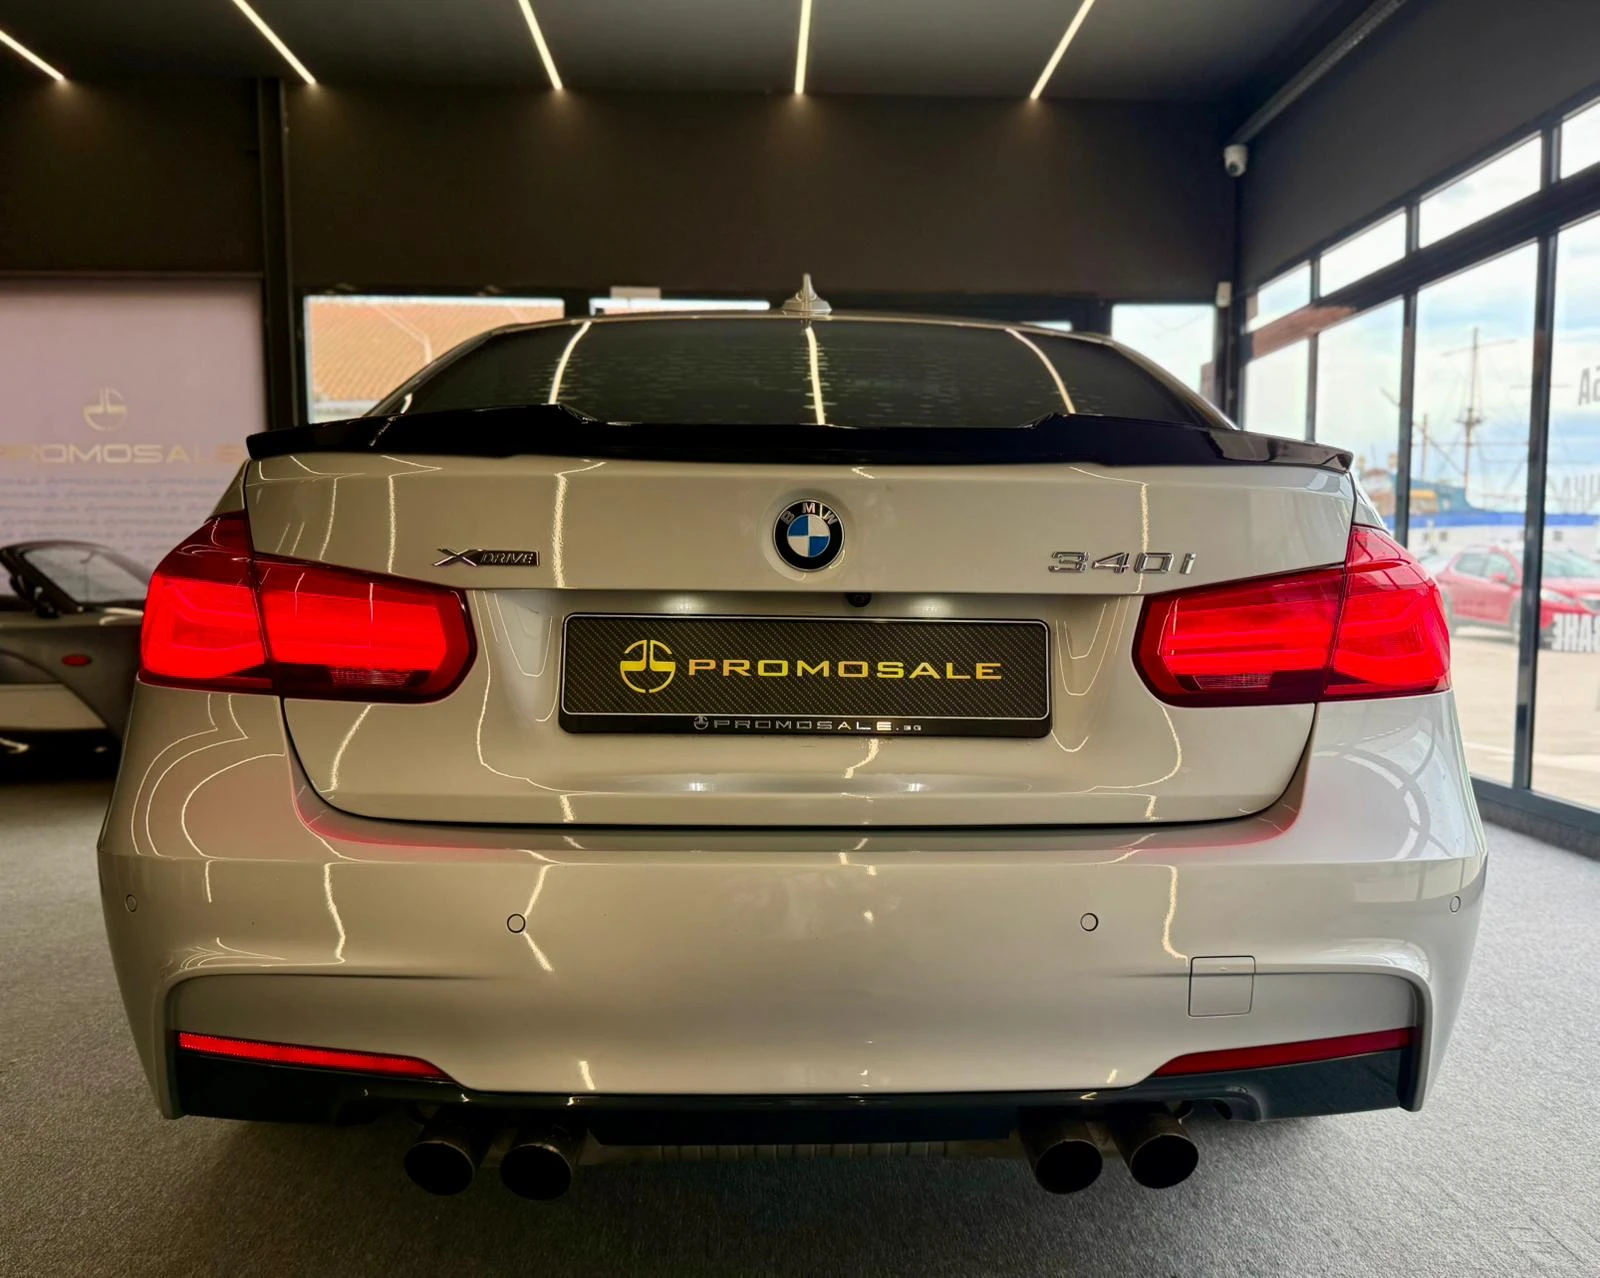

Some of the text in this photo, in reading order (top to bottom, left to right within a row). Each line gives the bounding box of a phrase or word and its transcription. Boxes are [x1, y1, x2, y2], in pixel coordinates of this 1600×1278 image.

[780, 502, 838, 525] BMW
[1048, 551, 1197, 575] 340i
[687, 658, 1003, 680] PROMOSALE
